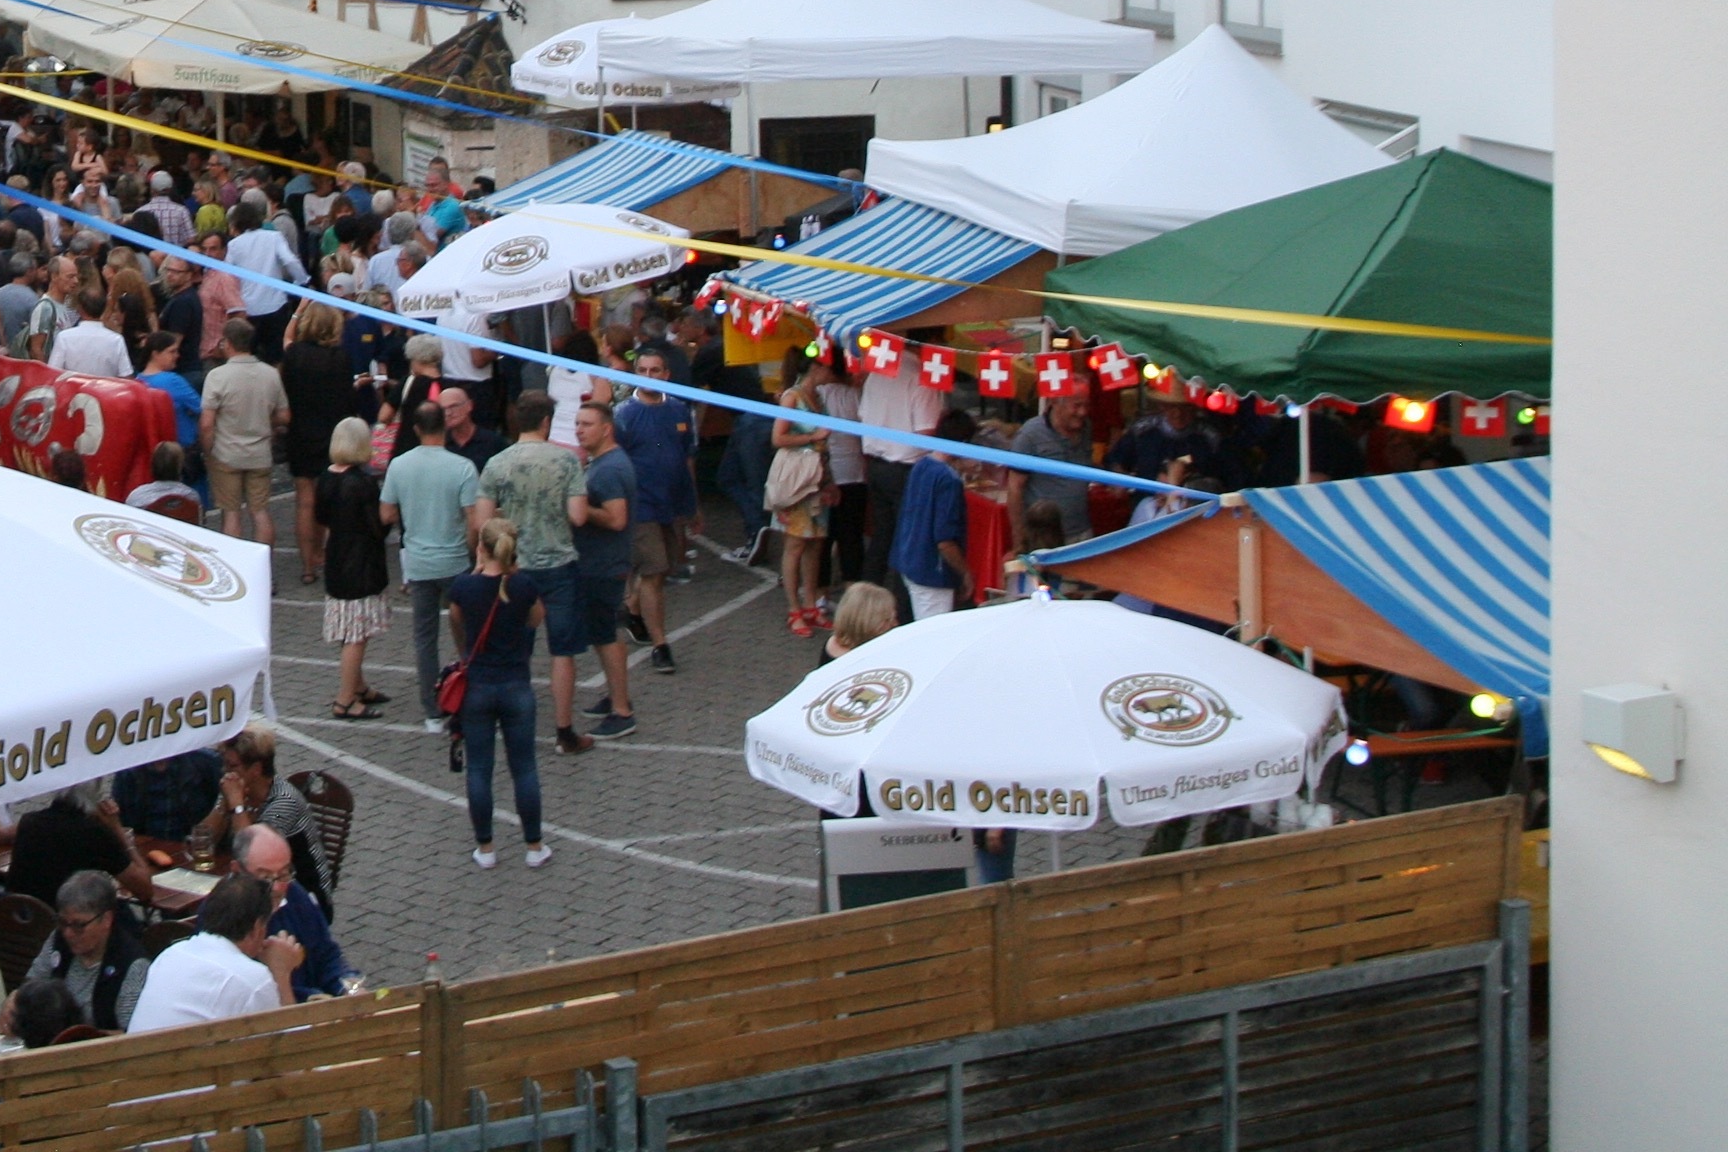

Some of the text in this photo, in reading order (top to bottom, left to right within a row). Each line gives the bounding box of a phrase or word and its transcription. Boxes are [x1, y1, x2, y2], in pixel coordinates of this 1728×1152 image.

[613, 252, 669, 279] Ochsen
[85, 684, 236, 755] Ochsen
[879, 778, 1090, 816] Gold Ochsen
[1120, 754, 1301, 806] Ulms flüssiges Gold
